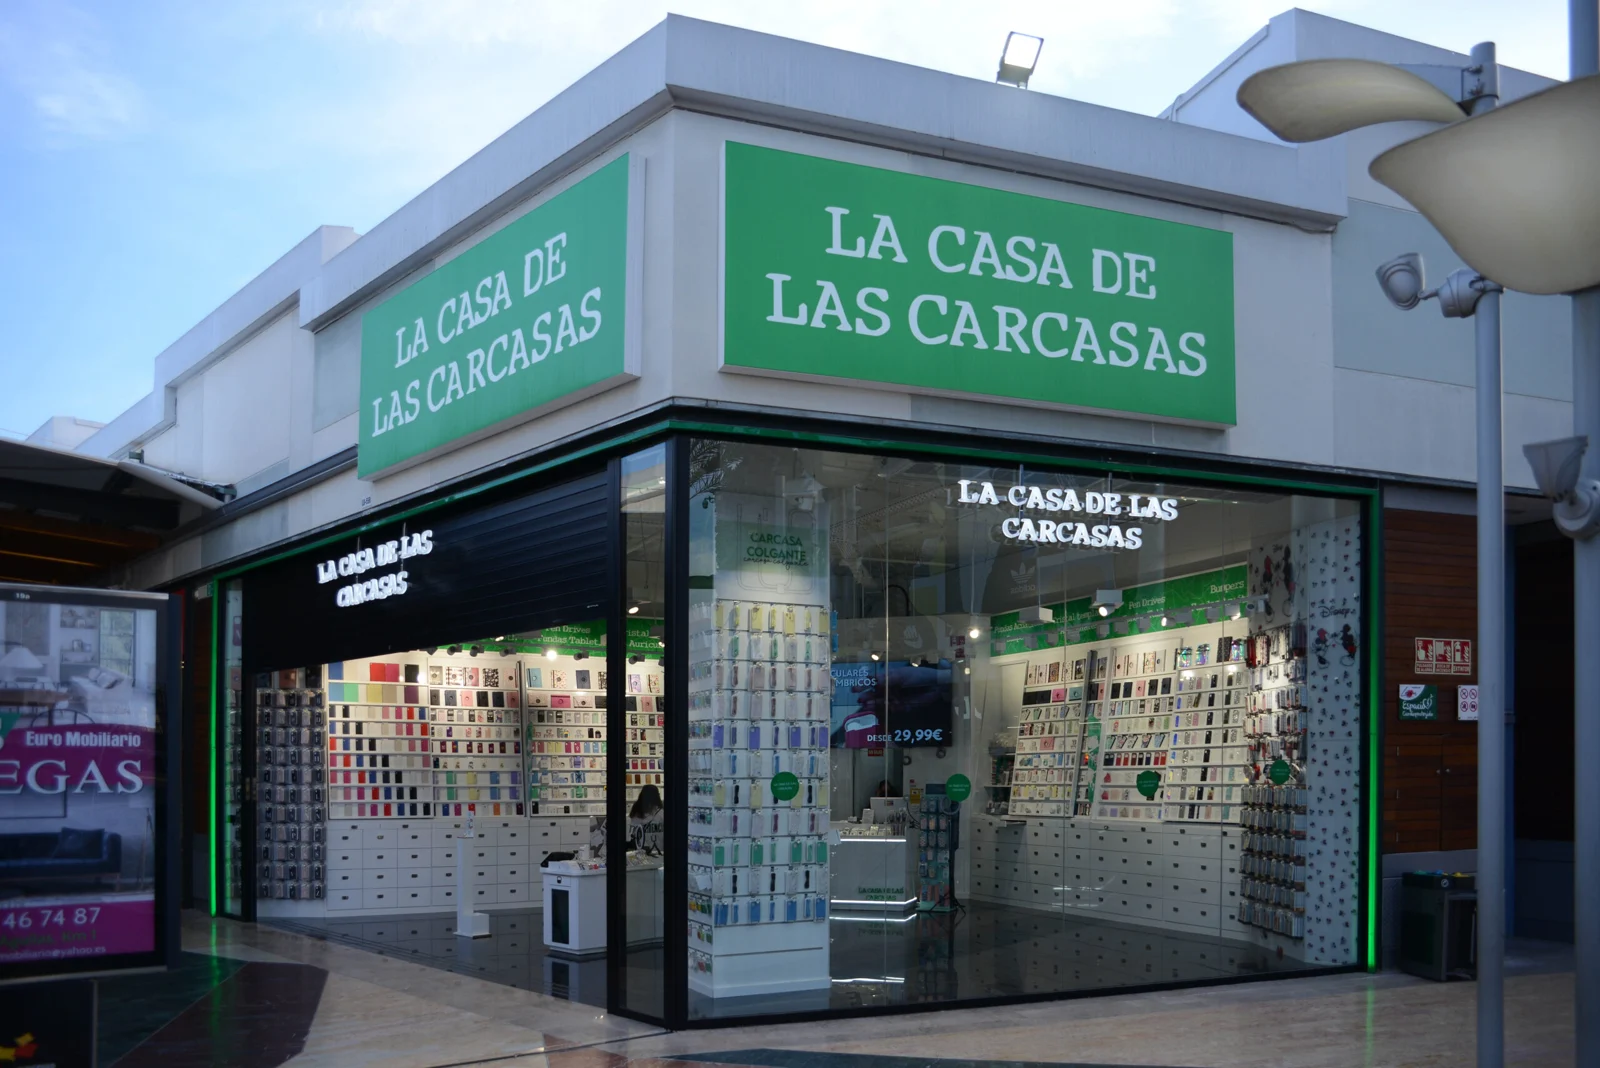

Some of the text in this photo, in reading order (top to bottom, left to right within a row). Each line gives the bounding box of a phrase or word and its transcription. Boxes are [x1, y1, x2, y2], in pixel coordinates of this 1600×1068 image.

[824, 206, 1157, 300] LA CASA DE
[394, 232, 567, 368] LA CASA DE
[765, 272, 1208, 378] LAS CARCASAS
[372, 286, 602, 437] LAS CARCASAS
[958, 479, 1178, 521] LA CASA DE LAS
[750, 531, 803, 547] CARCASA
[1002, 517, 1142, 550] CARCASAS
[317, 529, 433, 584] LA CASA DE LAS
[747, 546, 806, 562] COLGANTE
[336, 570, 408, 608] CARCASAS
[1210, 580, 1244, 594] Bumpers
[1128, 596, 1165, 610] Pen Drives
[562, 624, 591, 634] Drives
[25, 730, 63, 747] Euro
[65, 731, 142, 748] Mobiliario
[894, 728, 943, 744] 29,99€
[3, 906, 101, 929] 46 74 87
